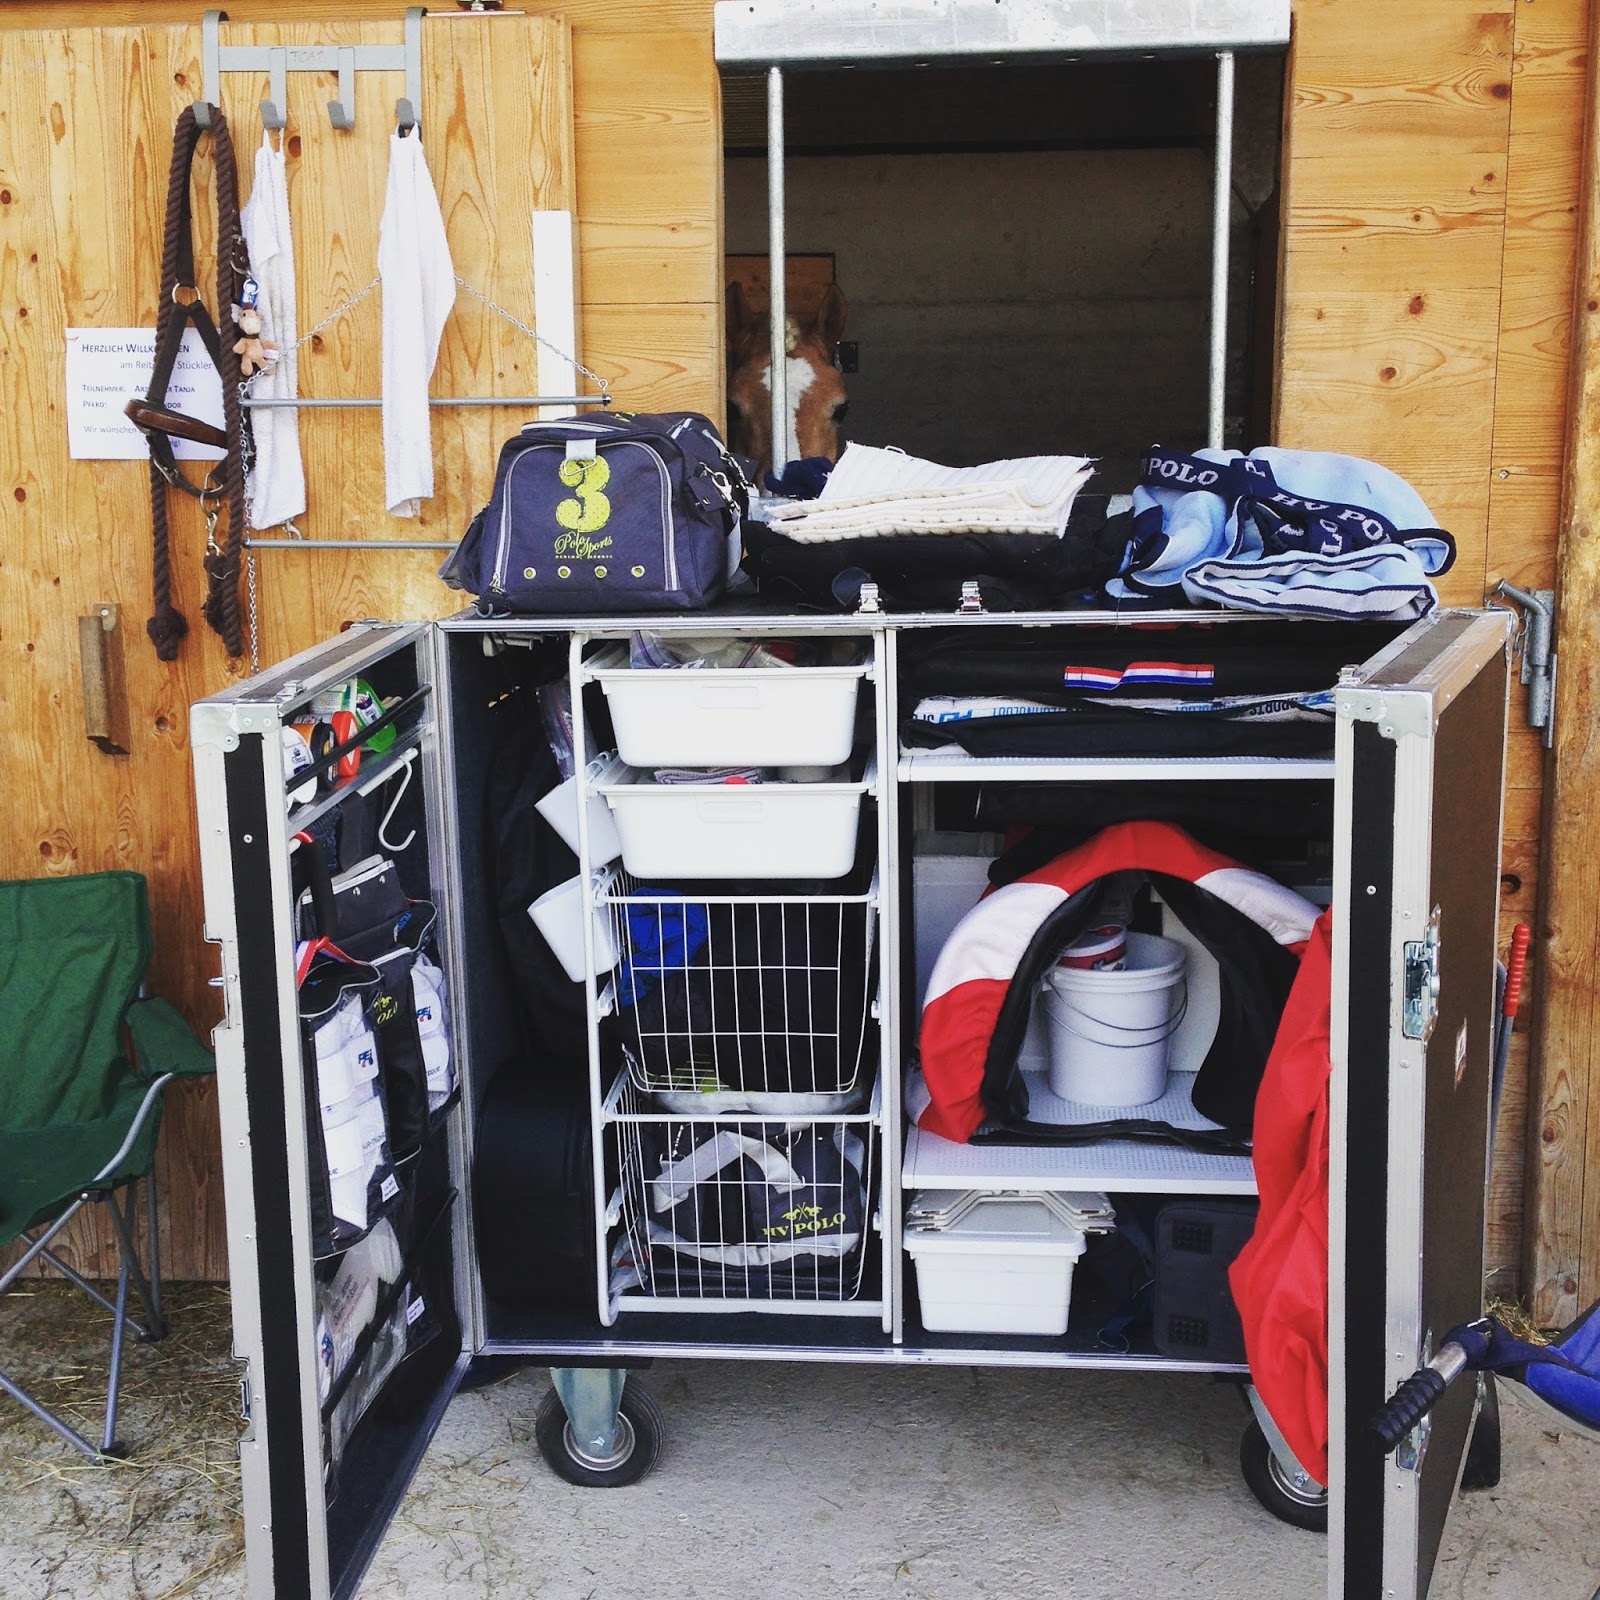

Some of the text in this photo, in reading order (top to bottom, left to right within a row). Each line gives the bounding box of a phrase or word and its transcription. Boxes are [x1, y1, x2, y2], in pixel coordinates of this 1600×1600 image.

[82, 344, 190, 353] HERZLICH WILLKEN
[177, 360, 212, 370] Stückler
[174, 385, 195, 393] TANJA
[100, 425, 137, 434] wünschen
[1147, 457, 1219, 486] POLO
[762, 1212, 848, 1237] HV POLO
